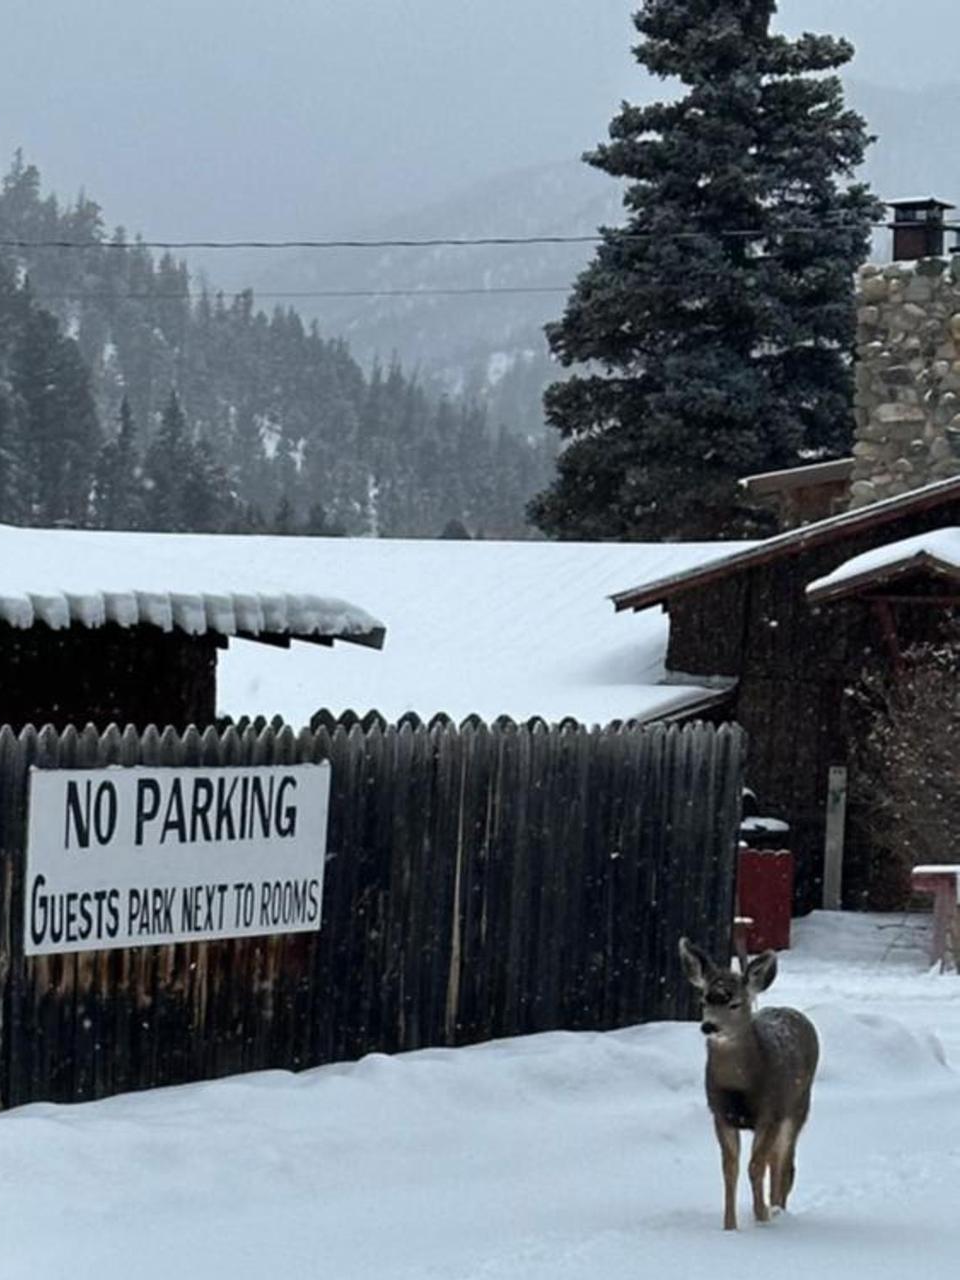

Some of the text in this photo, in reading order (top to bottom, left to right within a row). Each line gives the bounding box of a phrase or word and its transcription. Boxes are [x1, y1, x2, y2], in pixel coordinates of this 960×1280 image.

[65, 775, 297, 849] NO PARKING
[30, 874, 320, 945] GUESTS PARK NEXT TO ROOMS
